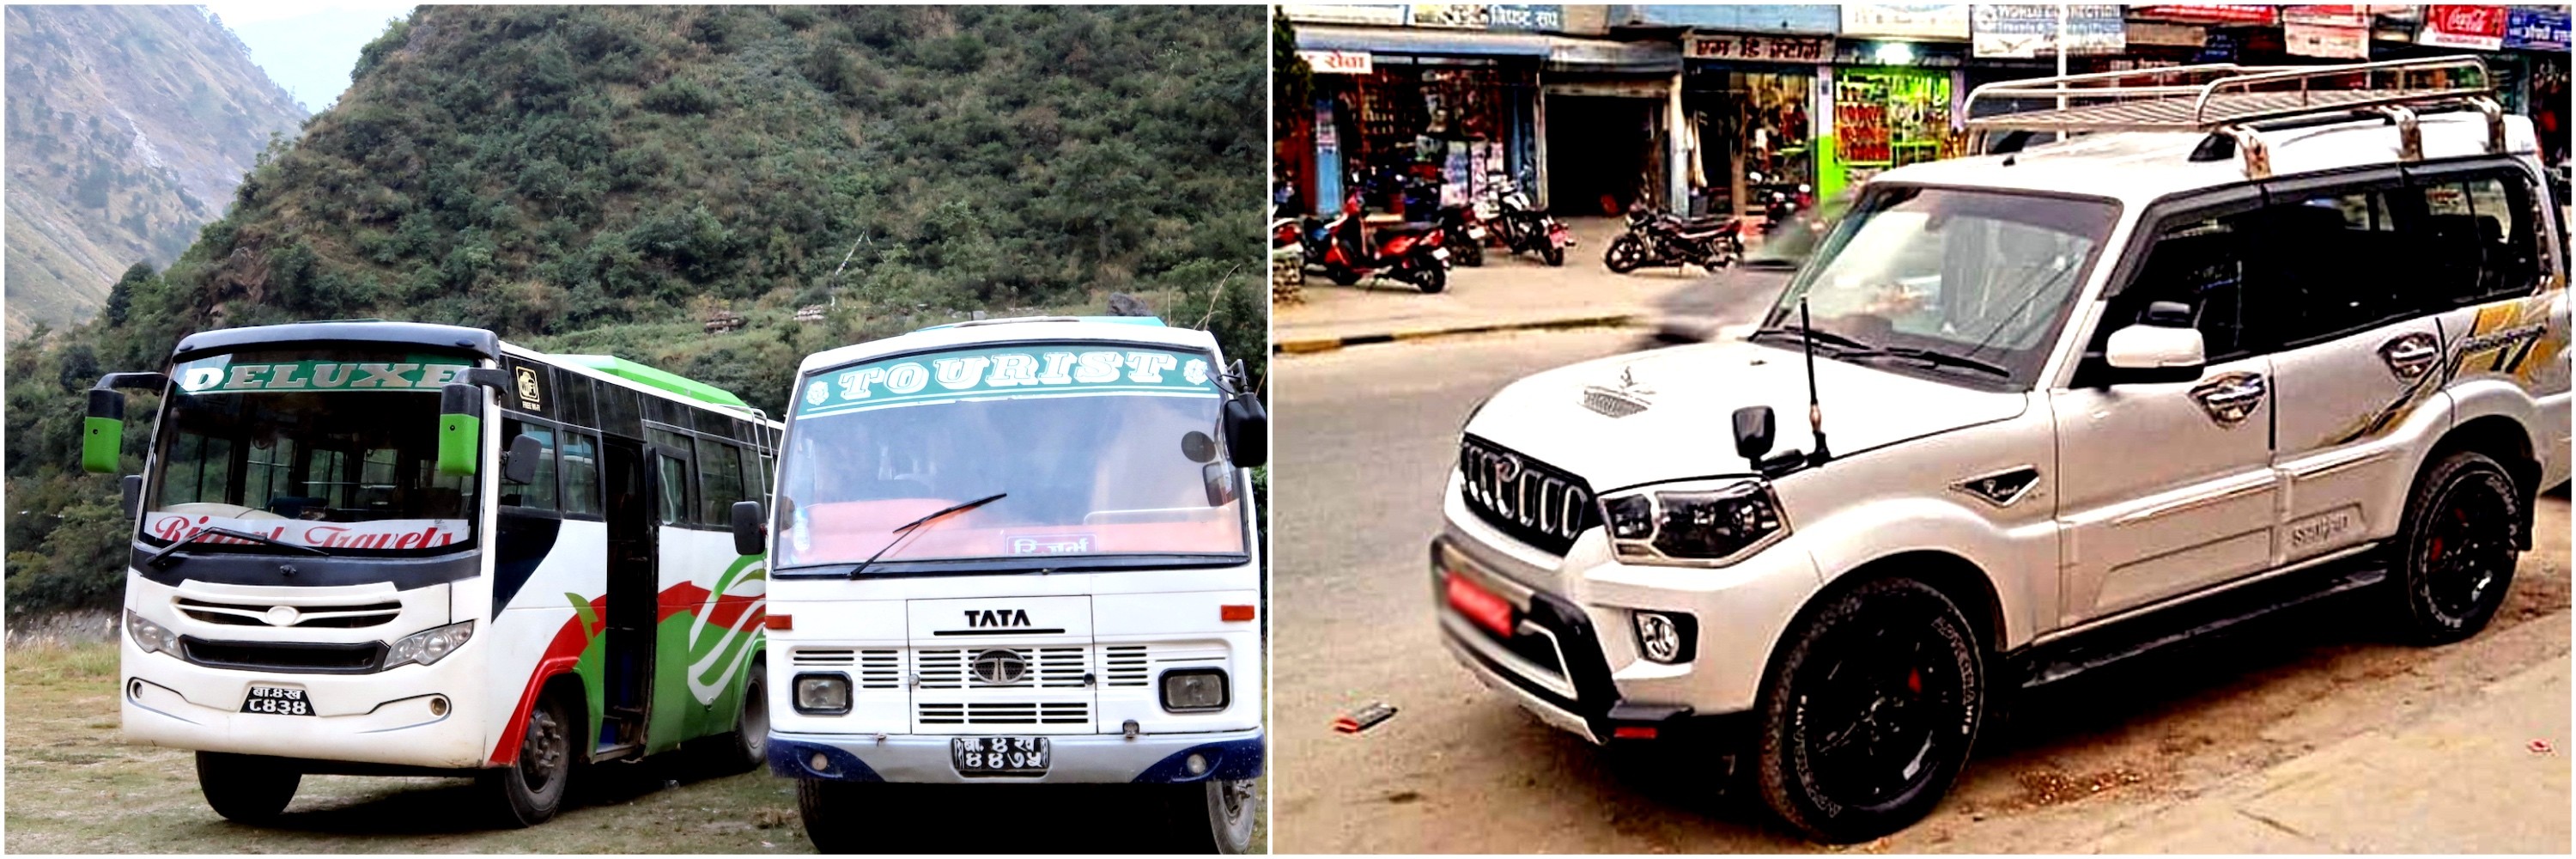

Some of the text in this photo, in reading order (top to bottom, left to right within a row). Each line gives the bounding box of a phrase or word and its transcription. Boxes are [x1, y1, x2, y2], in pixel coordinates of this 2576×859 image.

[2044, 5, 2121, 19] CONECTION
[181, 363, 472, 392] DELUXE
[839, 351, 1177, 400] TOURIST
[155, 515, 285, 545] Bil
[964, 609, 1031, 628] TATA
